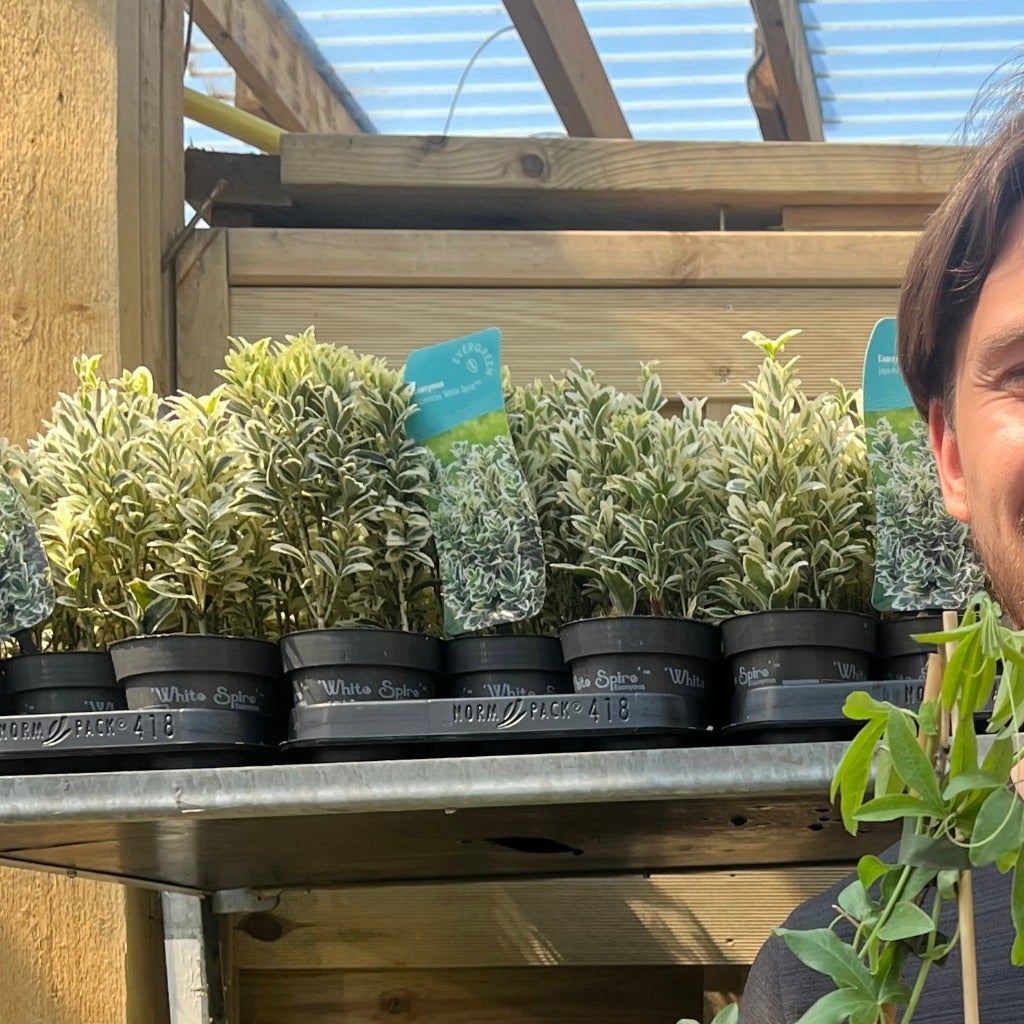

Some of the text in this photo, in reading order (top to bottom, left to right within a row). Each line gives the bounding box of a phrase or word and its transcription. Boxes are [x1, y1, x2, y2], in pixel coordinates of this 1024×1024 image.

[451, 342, 495, 376] EVERGREEN
[588, 697, 630, 724] 418
[133, 713, 175, 740] 418
